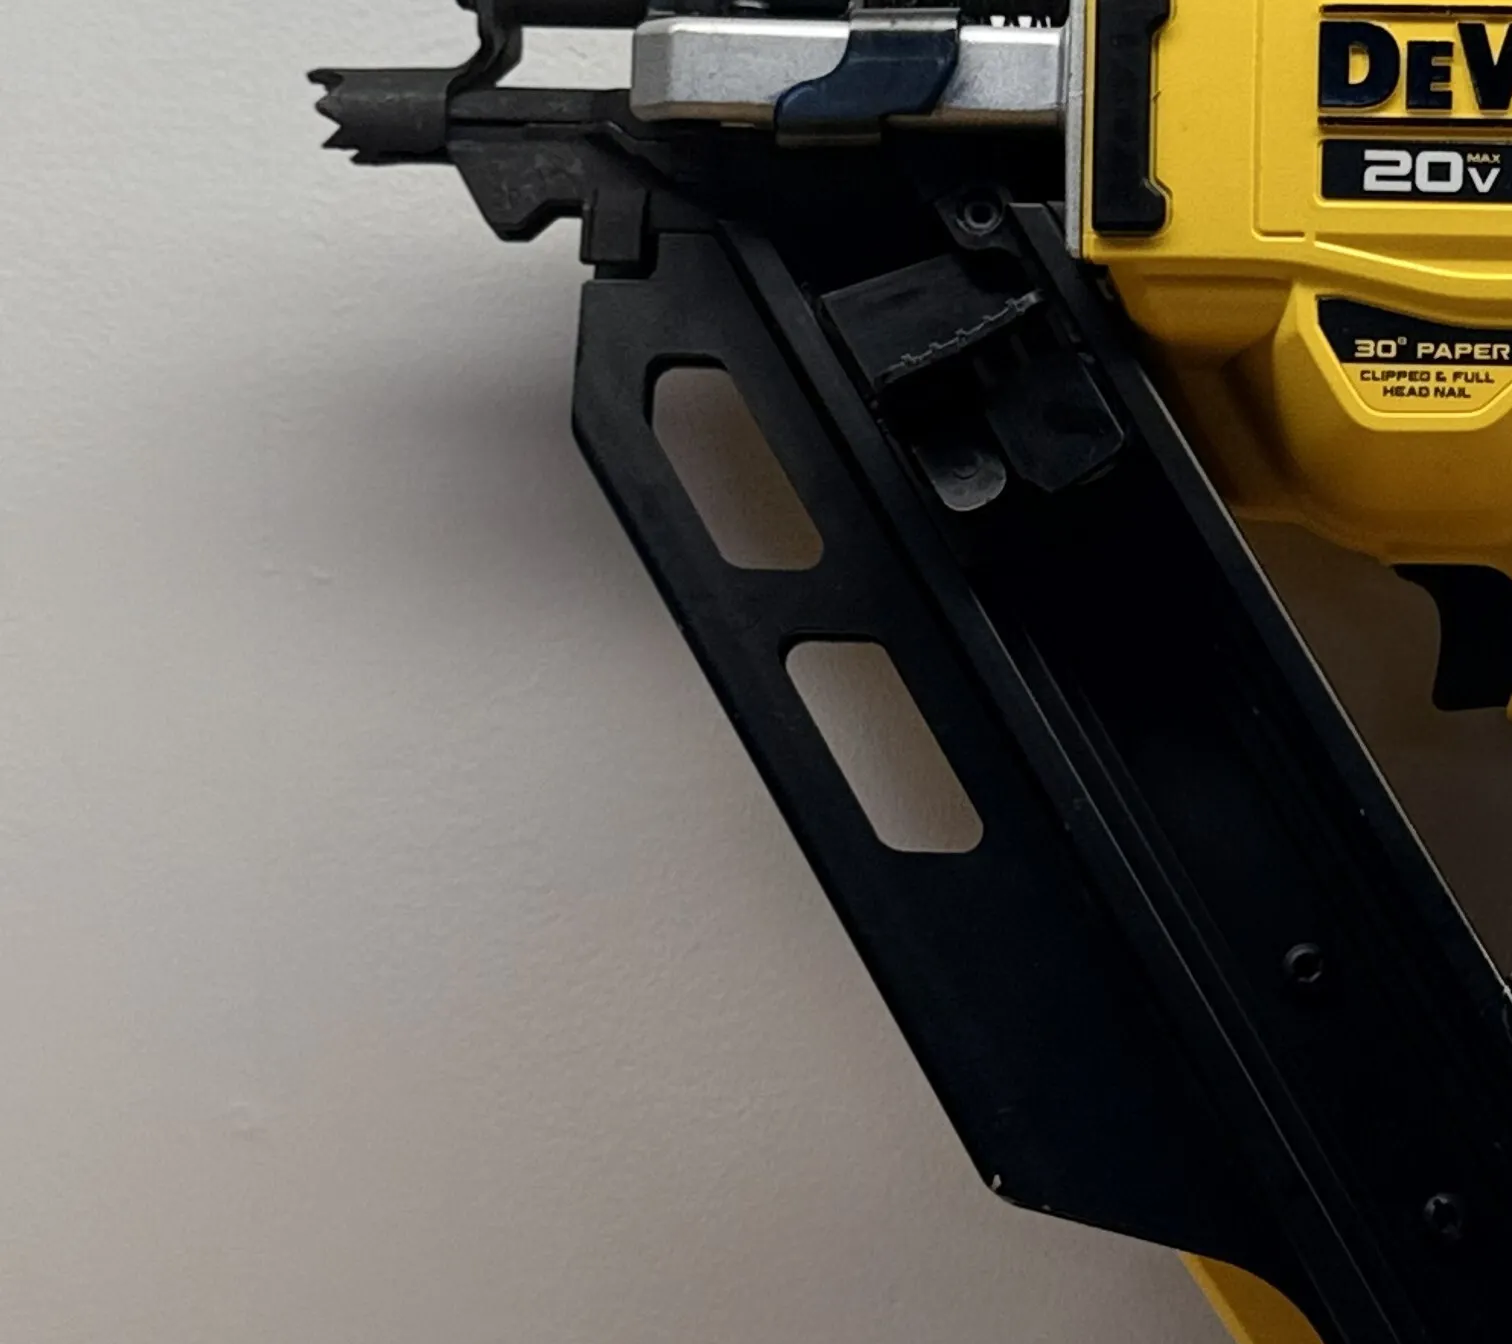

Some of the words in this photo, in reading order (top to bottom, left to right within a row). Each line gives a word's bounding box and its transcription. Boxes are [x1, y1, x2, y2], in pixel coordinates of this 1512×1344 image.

[1466, 152, 1501, 164] MAX
[1416, 342, 1511, 361] PAPER
[1359, 369, 1431, 383] CLIPPED
[1435, 370, 1448, 383] &
[1452, 371, 1496, 384] FULL
[1382, 385, 1431, 398] HEAD
[1433, 386, 1472, 399] NAIL
